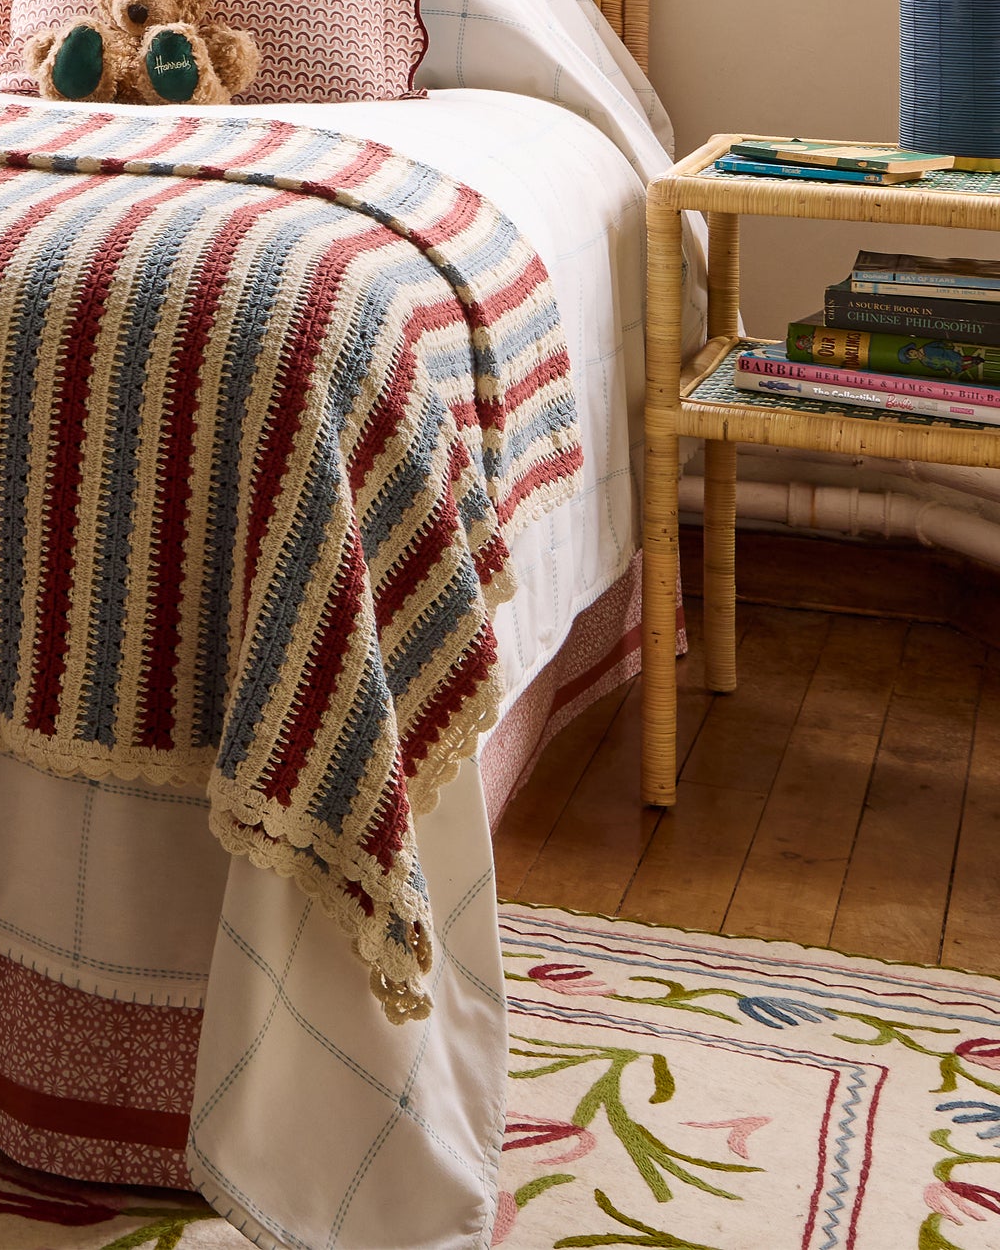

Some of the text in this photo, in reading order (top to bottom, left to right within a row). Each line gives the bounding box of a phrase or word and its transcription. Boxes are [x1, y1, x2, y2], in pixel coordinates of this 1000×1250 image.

[154, 55, 192, 75] Harrods
[855, 302, 892, 312] SOURCE
[893, 304, 920, 315] BOOK
[921, 308, 933, 316] IN
[847, 311, 985, 334] CHINESE PHILOSOPHY
[817, 337, 836, 357] OUR
[843, 332, 861, 367] DARLINGS
[741, 359, 807, 378] BARBIE
[815, 371, 839, 381] HER
[846, 375, 874, 387] LIFE
[880, 380, 888, 388] &
[893, 381, 933, 394] TIMES
[943, 388, 955, 399] by
[812, 387, 831, 397] The
[831, 390, 882, 404] Collectible
[885, 393, 915, 411] Barbie
